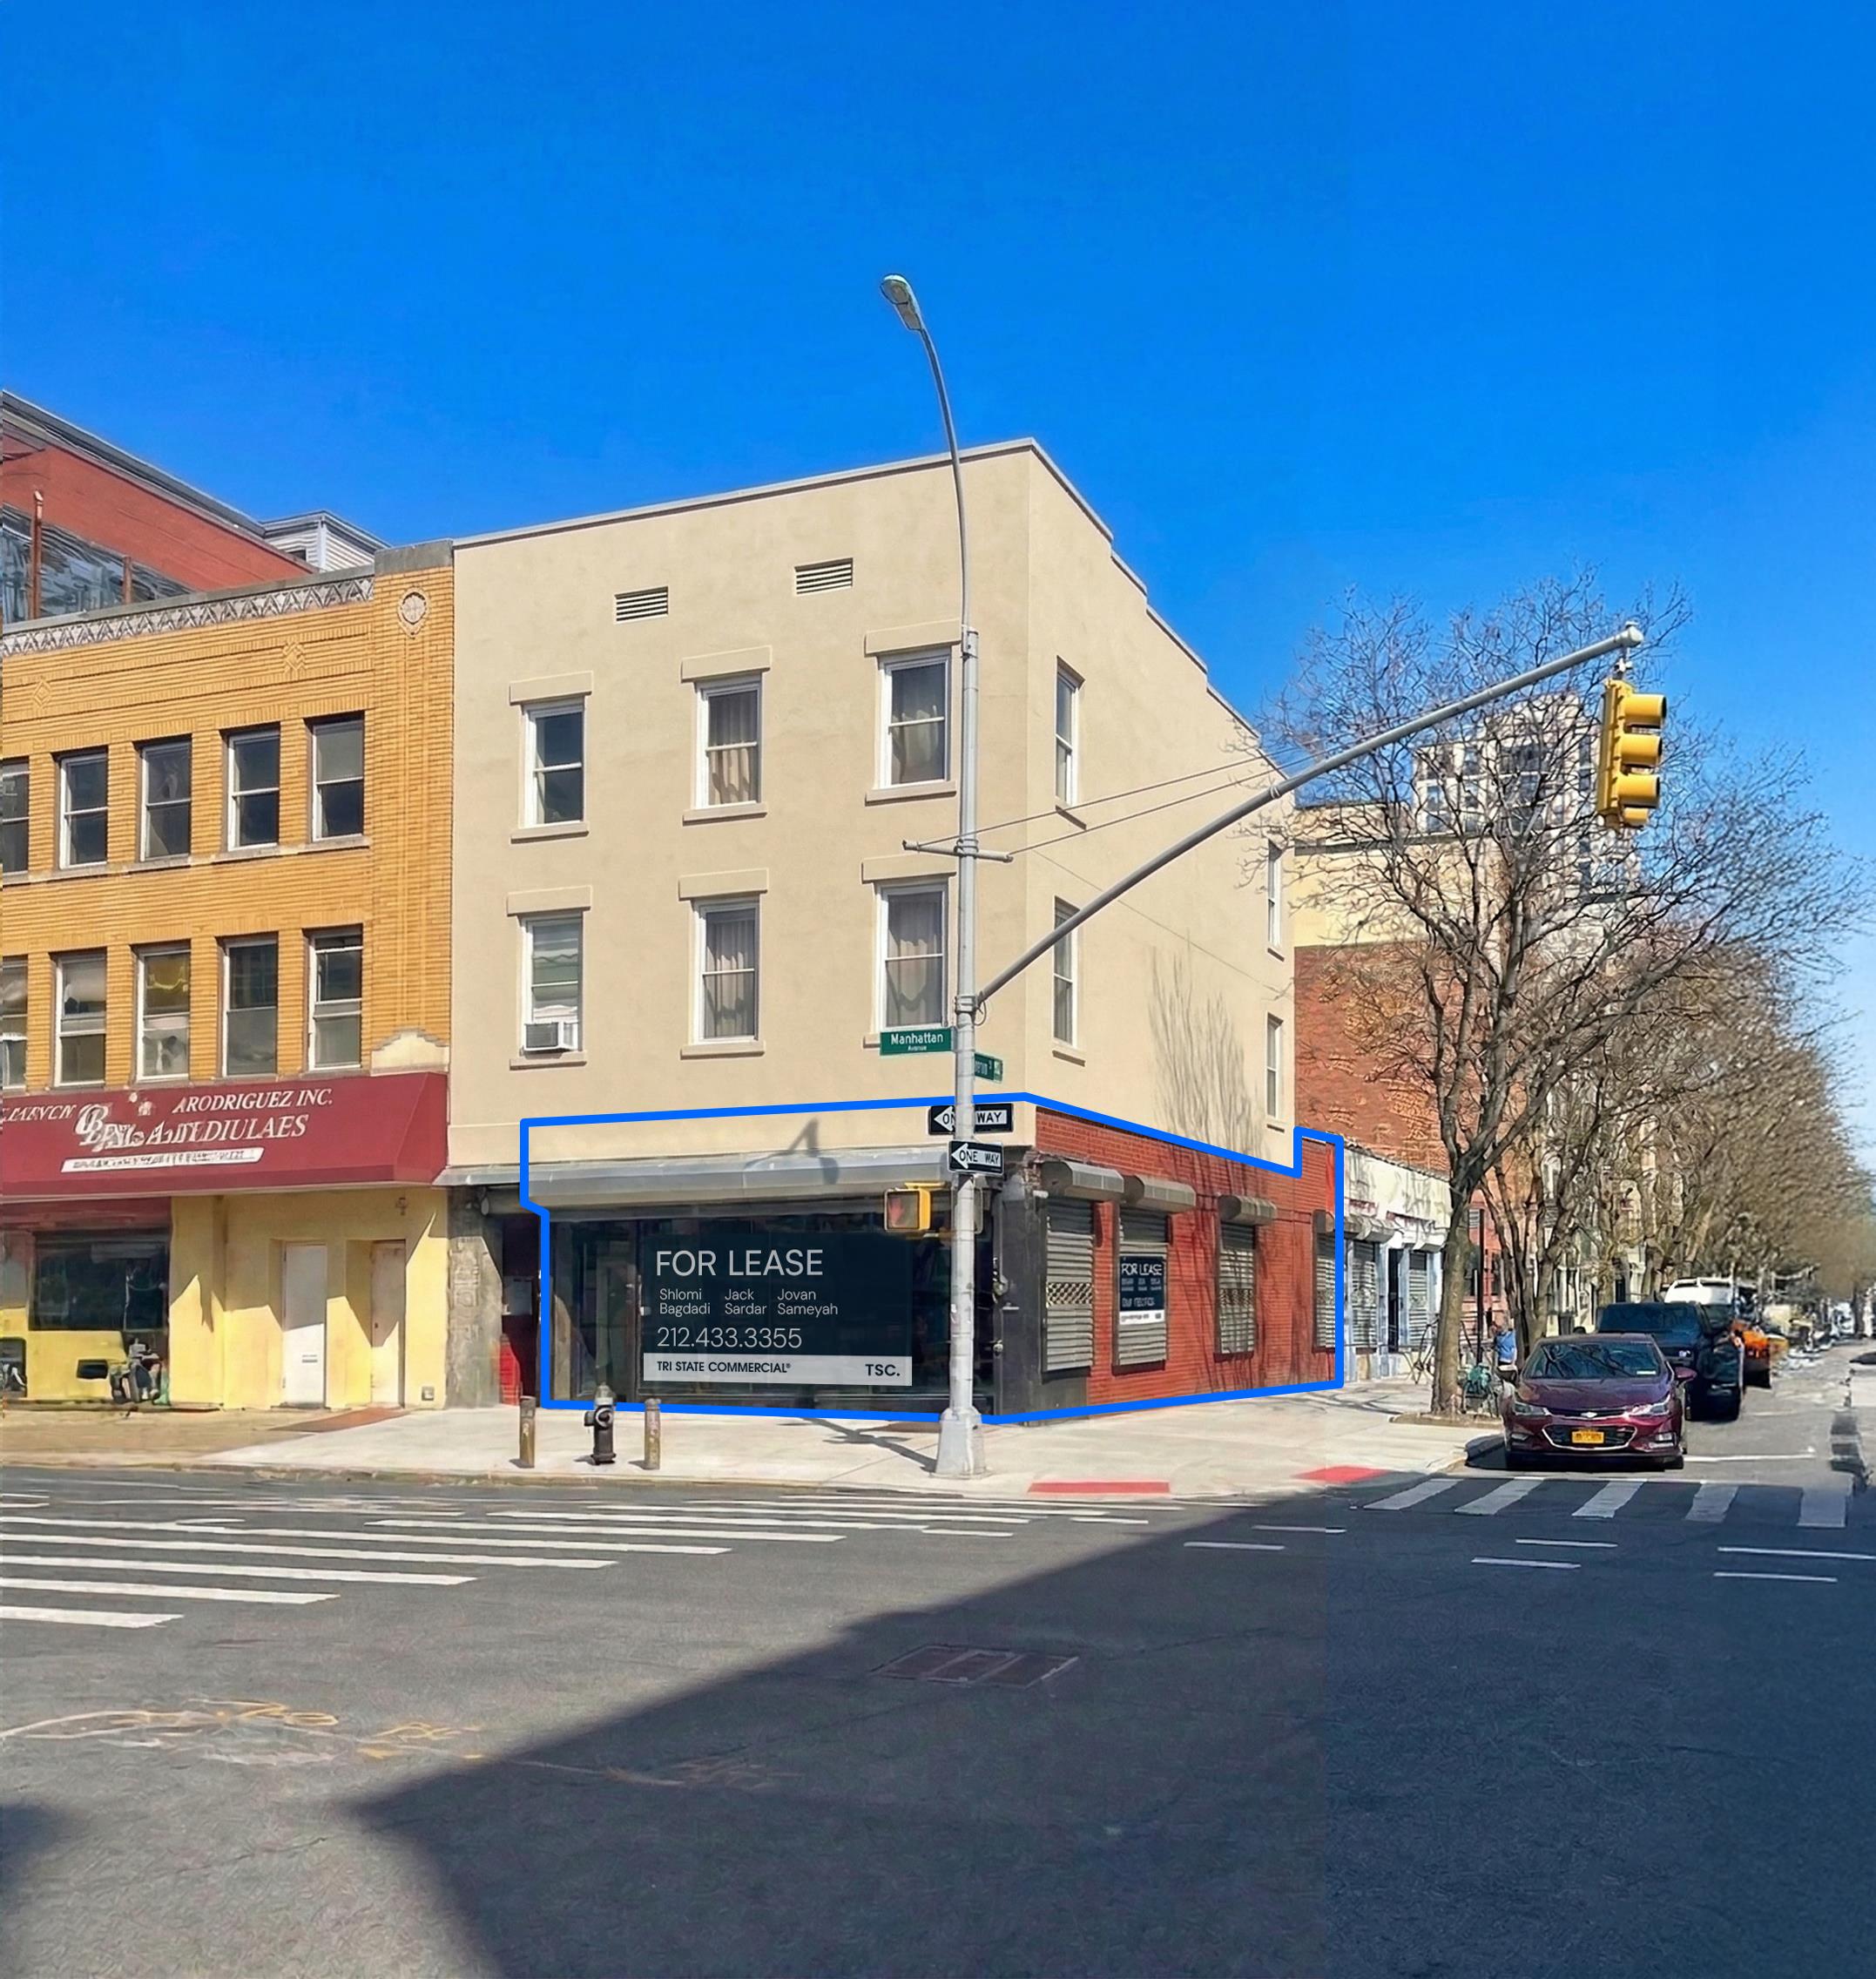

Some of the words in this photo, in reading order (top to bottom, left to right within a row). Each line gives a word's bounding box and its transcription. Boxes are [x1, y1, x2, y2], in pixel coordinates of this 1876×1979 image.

[890, 1031, 944, 1045] Manhattan
[296, 1088, 334, 1107] INC.
[976, 1111, 1002, 1124] WAY
[959, 1149, 978, 1163] ONE
[984, 1152, 1000, 1165] WAY
[656, 1249, 717, 1277] FOR
[728, 1248, 824, 1277] LEASE
[659, 1287, 703, 1300] Shlomi
[724, 1288, 754, 1300] Jack
[777, 1288, 817, 1300] Jovan
[659, 1302, 712, 1318] Bagdadi
[724, 1302, 767, 1315] Sardar
[777, 1303, 839, 1318] Sameyah
[657, 1327, 803, 1349] 212.433.3355
[657, 1361, 672, 1372] TRI
[675, 1361, 705, 1372] STATE
[865, 1363, 901, 1377] TSC.
